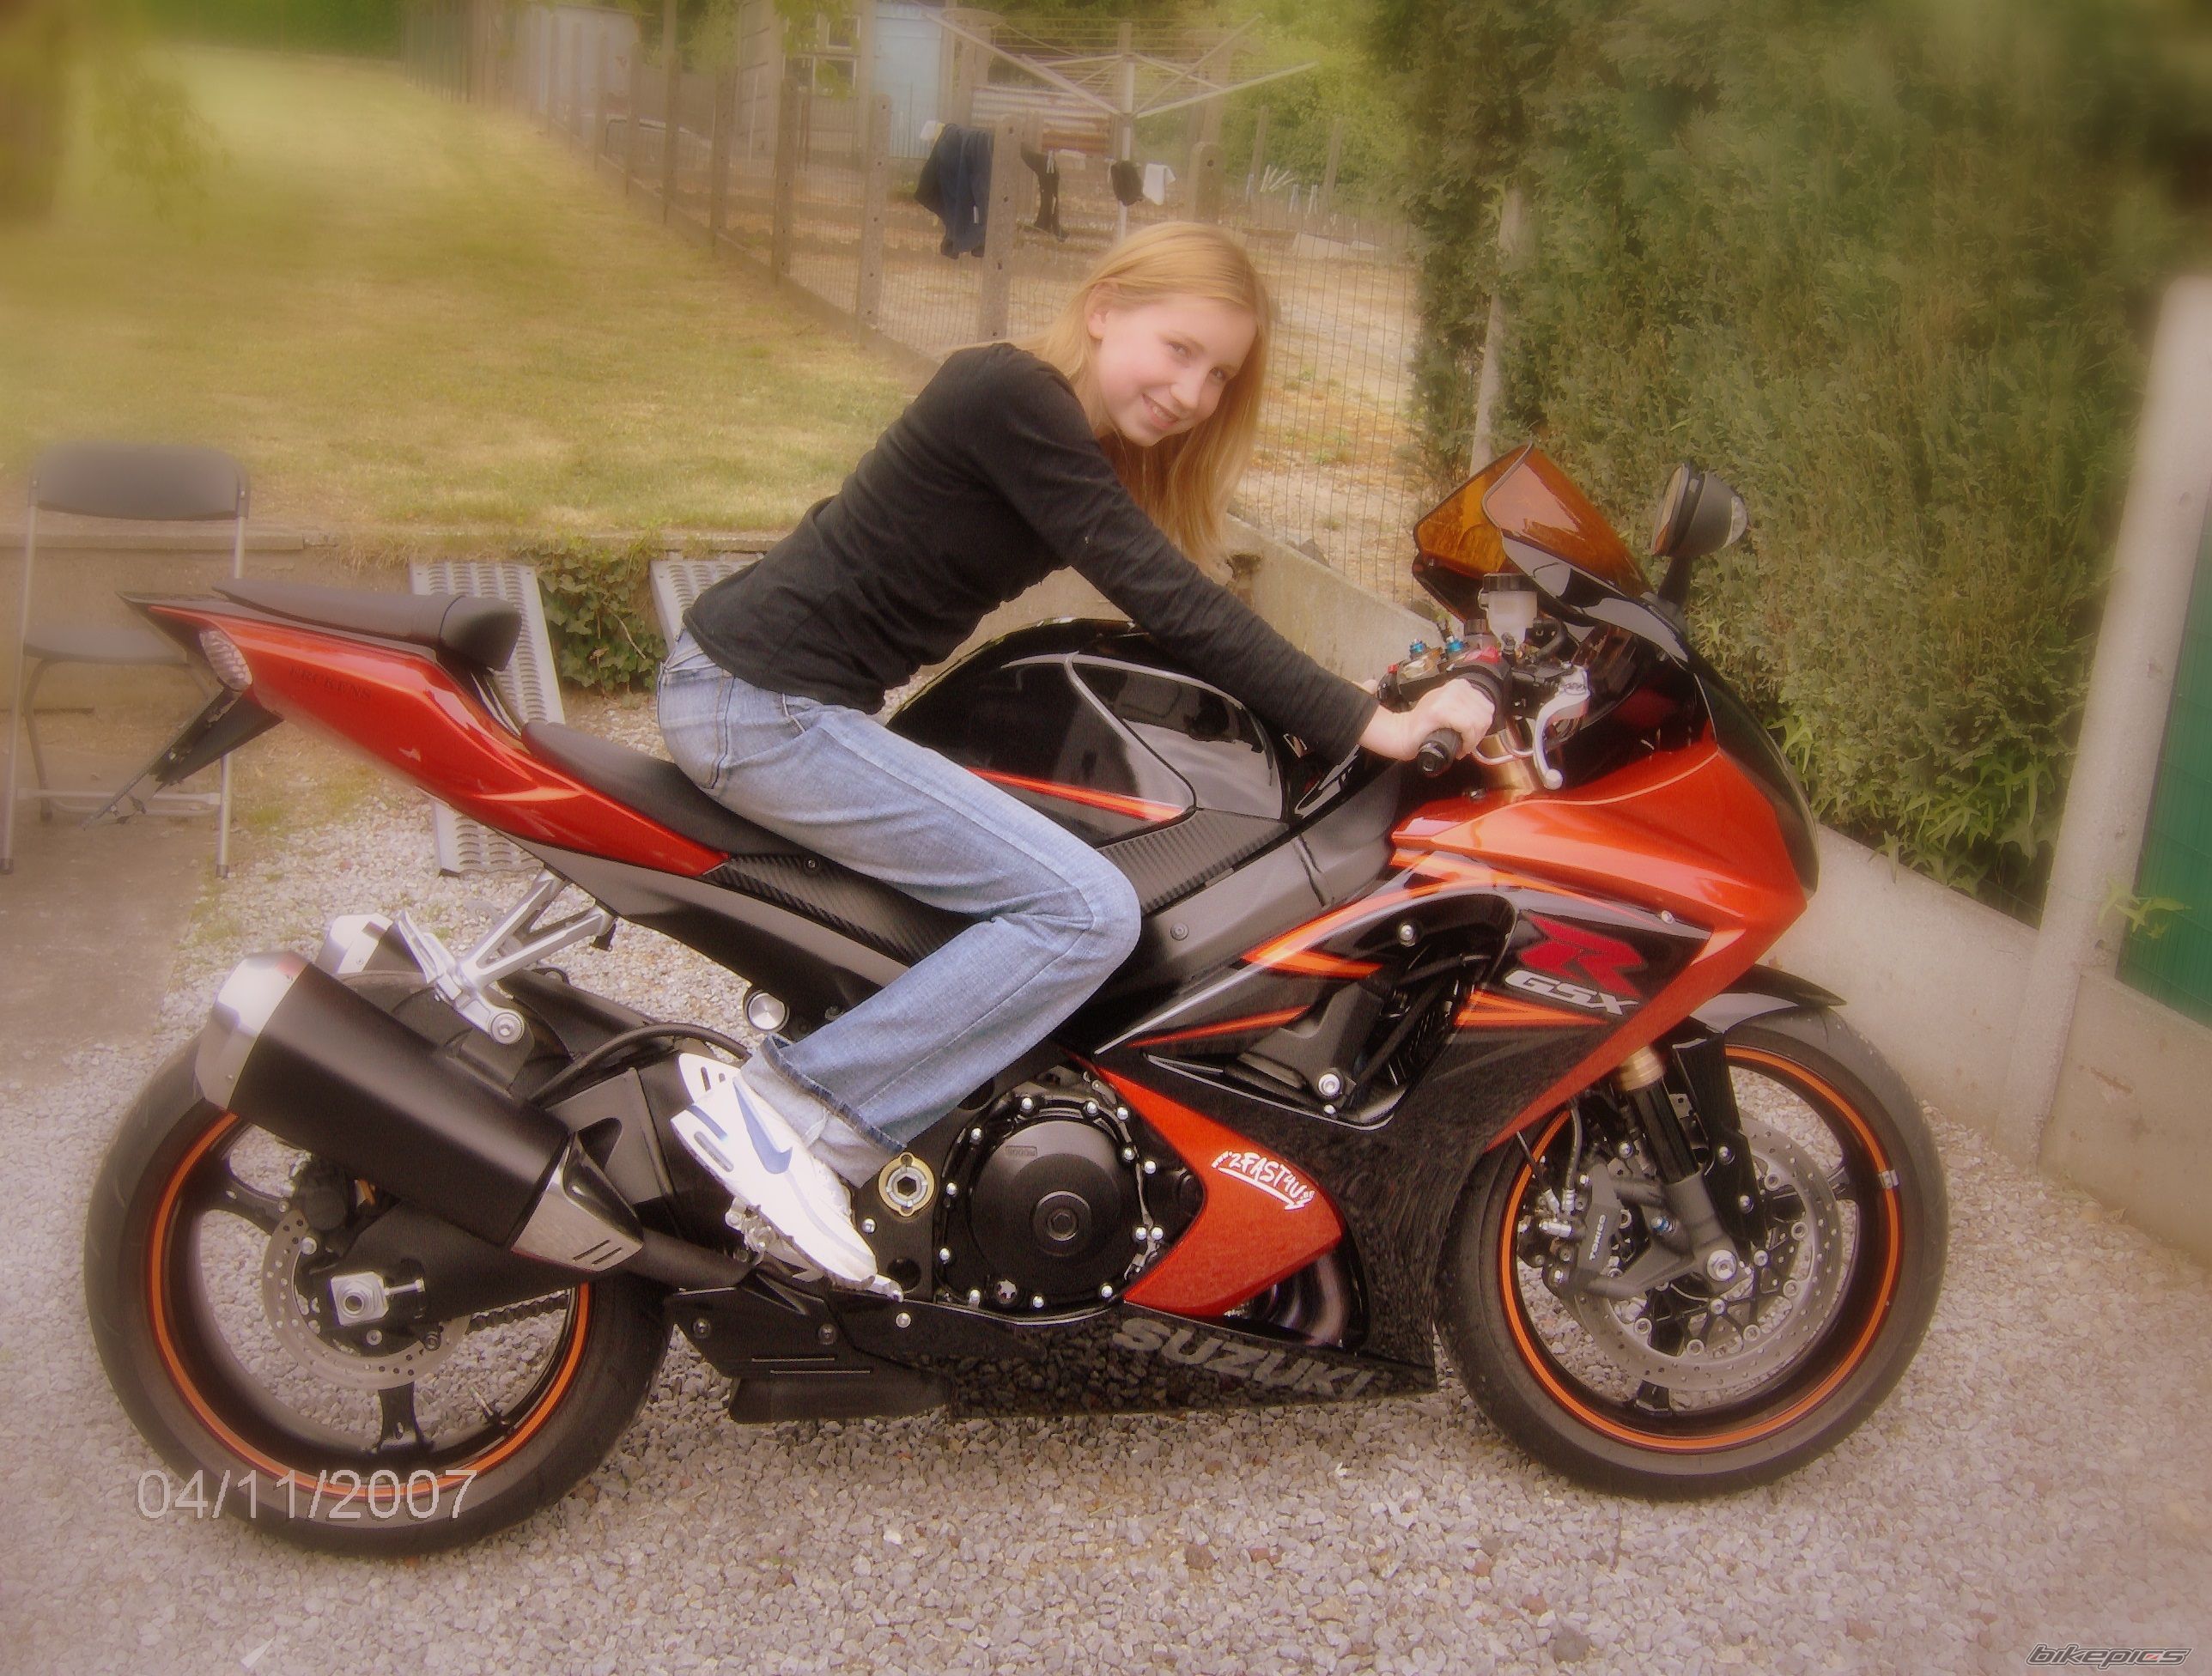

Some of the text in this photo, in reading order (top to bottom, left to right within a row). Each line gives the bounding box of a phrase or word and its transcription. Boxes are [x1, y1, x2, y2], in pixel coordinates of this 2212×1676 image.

[1505, 969, 1639, 1016] GSX
[1519, 913, 1644, 999] R
[1113, 1317, 1375, 1400] SUZUKI
